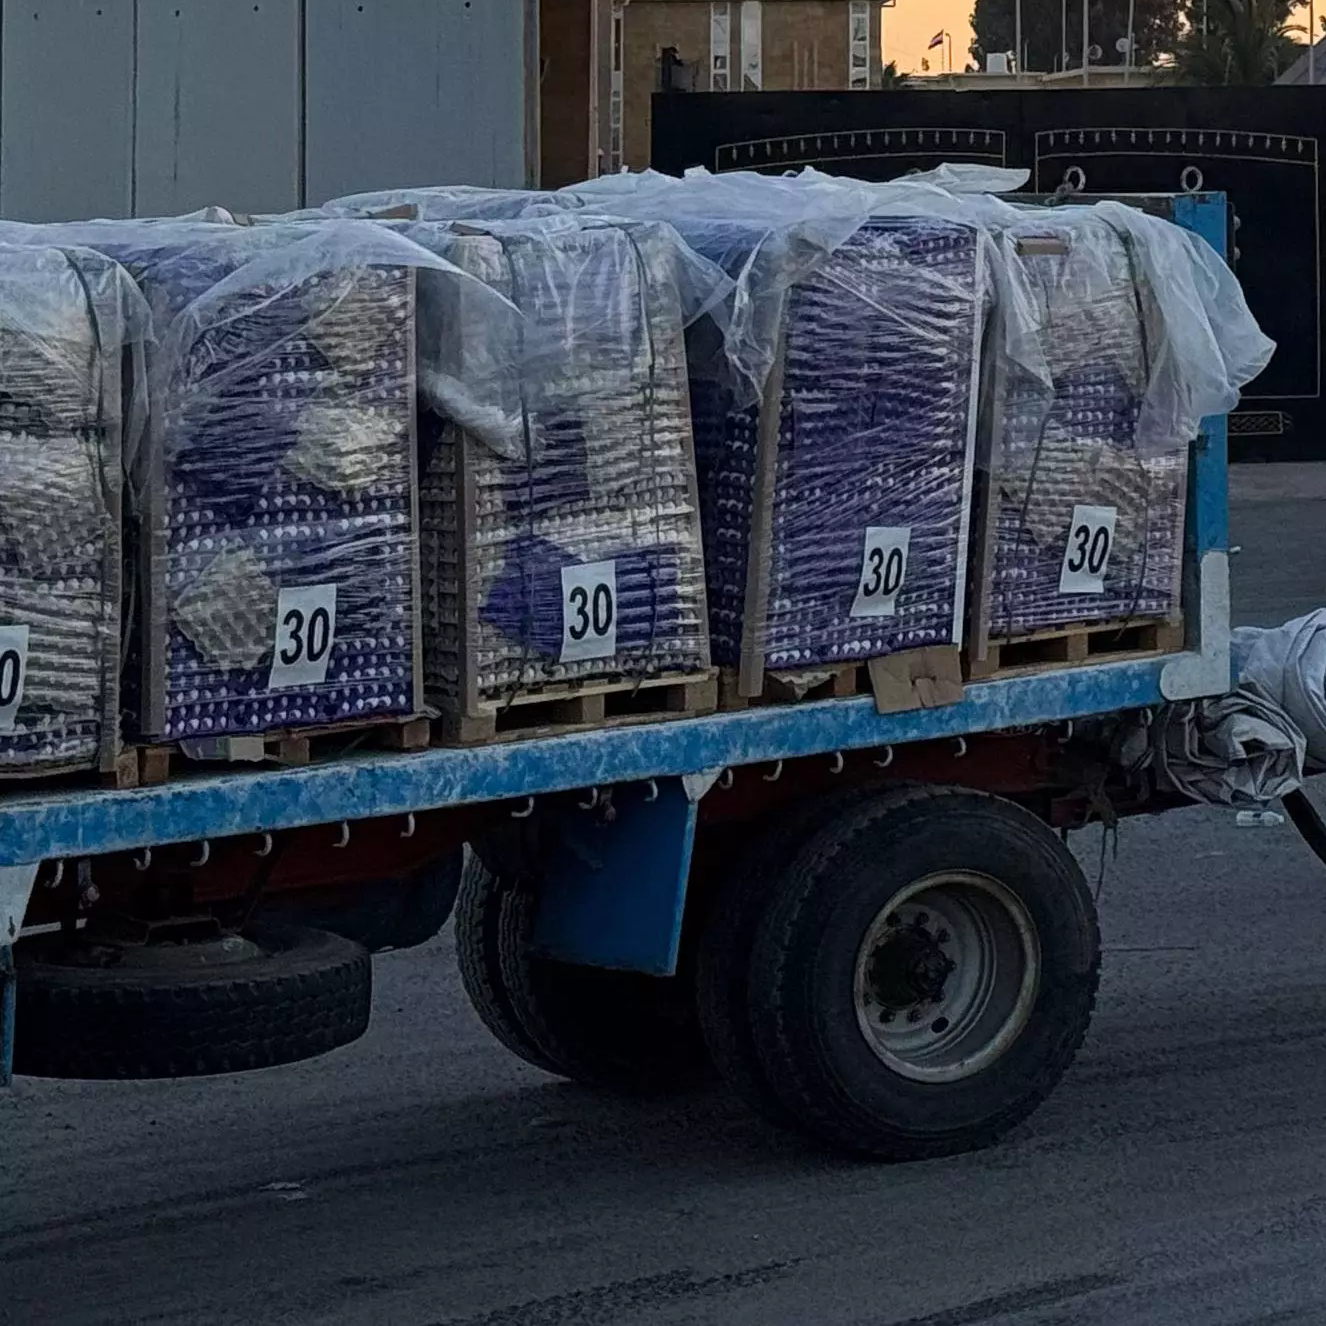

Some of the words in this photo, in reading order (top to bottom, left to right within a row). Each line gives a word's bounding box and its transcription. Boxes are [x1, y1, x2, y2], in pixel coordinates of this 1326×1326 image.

[863, 547, 904, 598] 30
[1068, 524, 1110, 574] 30
[279, 607, 330, 665] 30
[568, 582, 613, 641] 30
[0, 648, 21, 707] 0
